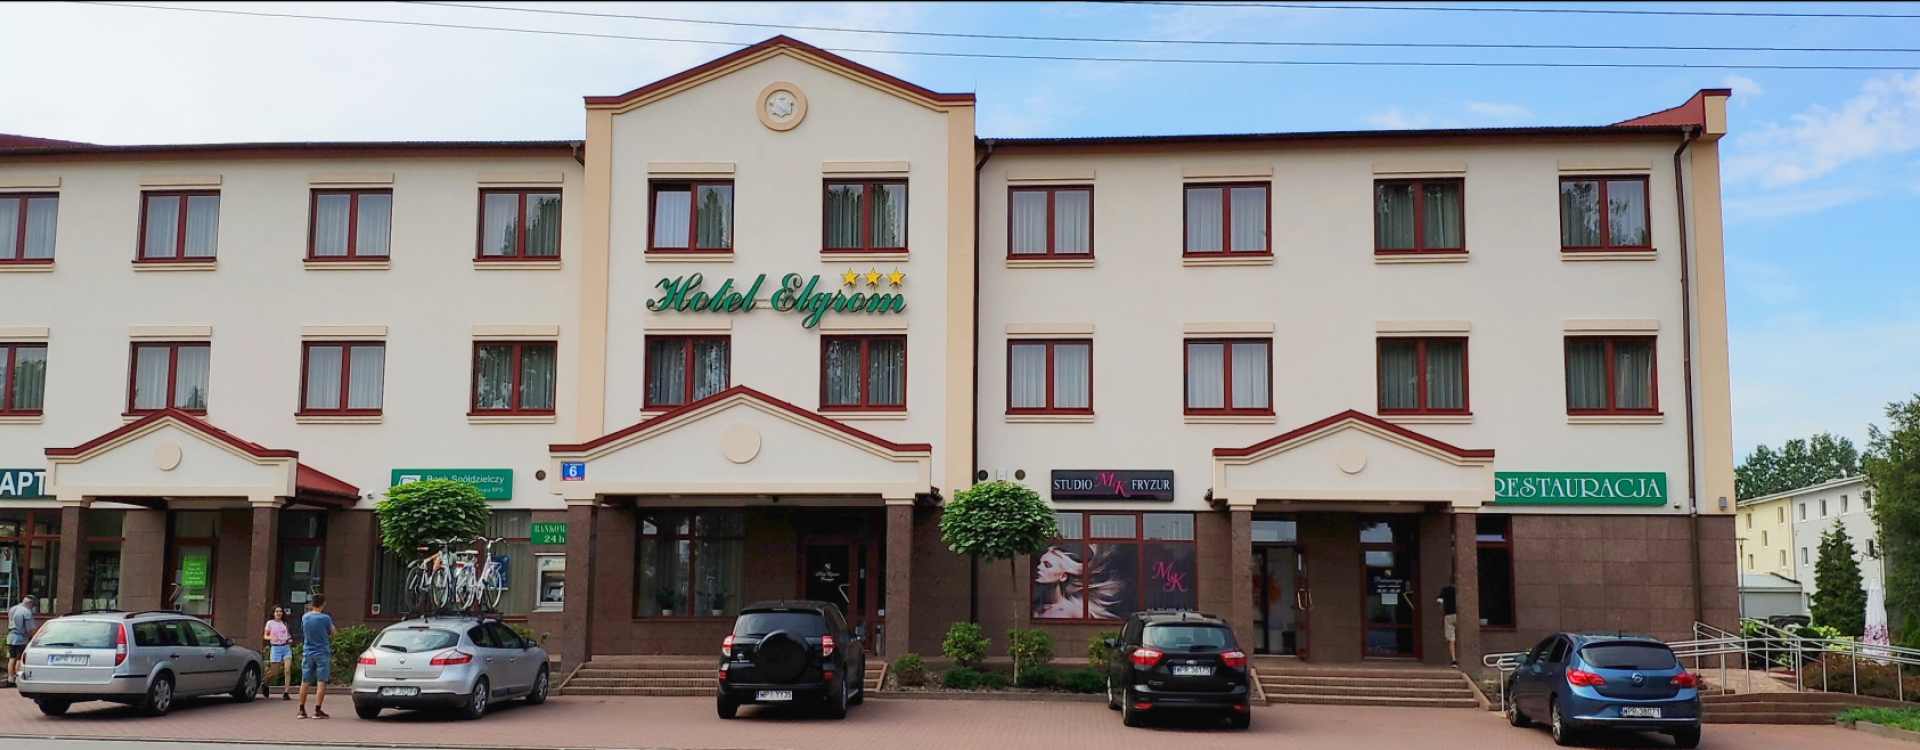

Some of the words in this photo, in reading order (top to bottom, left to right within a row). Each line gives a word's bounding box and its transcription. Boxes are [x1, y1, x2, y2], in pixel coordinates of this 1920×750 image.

[646, 272, 767, 313] Hotel
[770, 273, 907, 329] Elgrom
[569, 465, 578, 477] 6
[1053, 478, 1093, 490] STUDIO
[1131, 478, 1171, 490] FRYZUR
[1495, 477, 1663, 498] RESTAURACJA
[534, 524, 566, 533] BANKOM
[544, 534, 557, 543] 24
[558, 534, 565, 543] h
